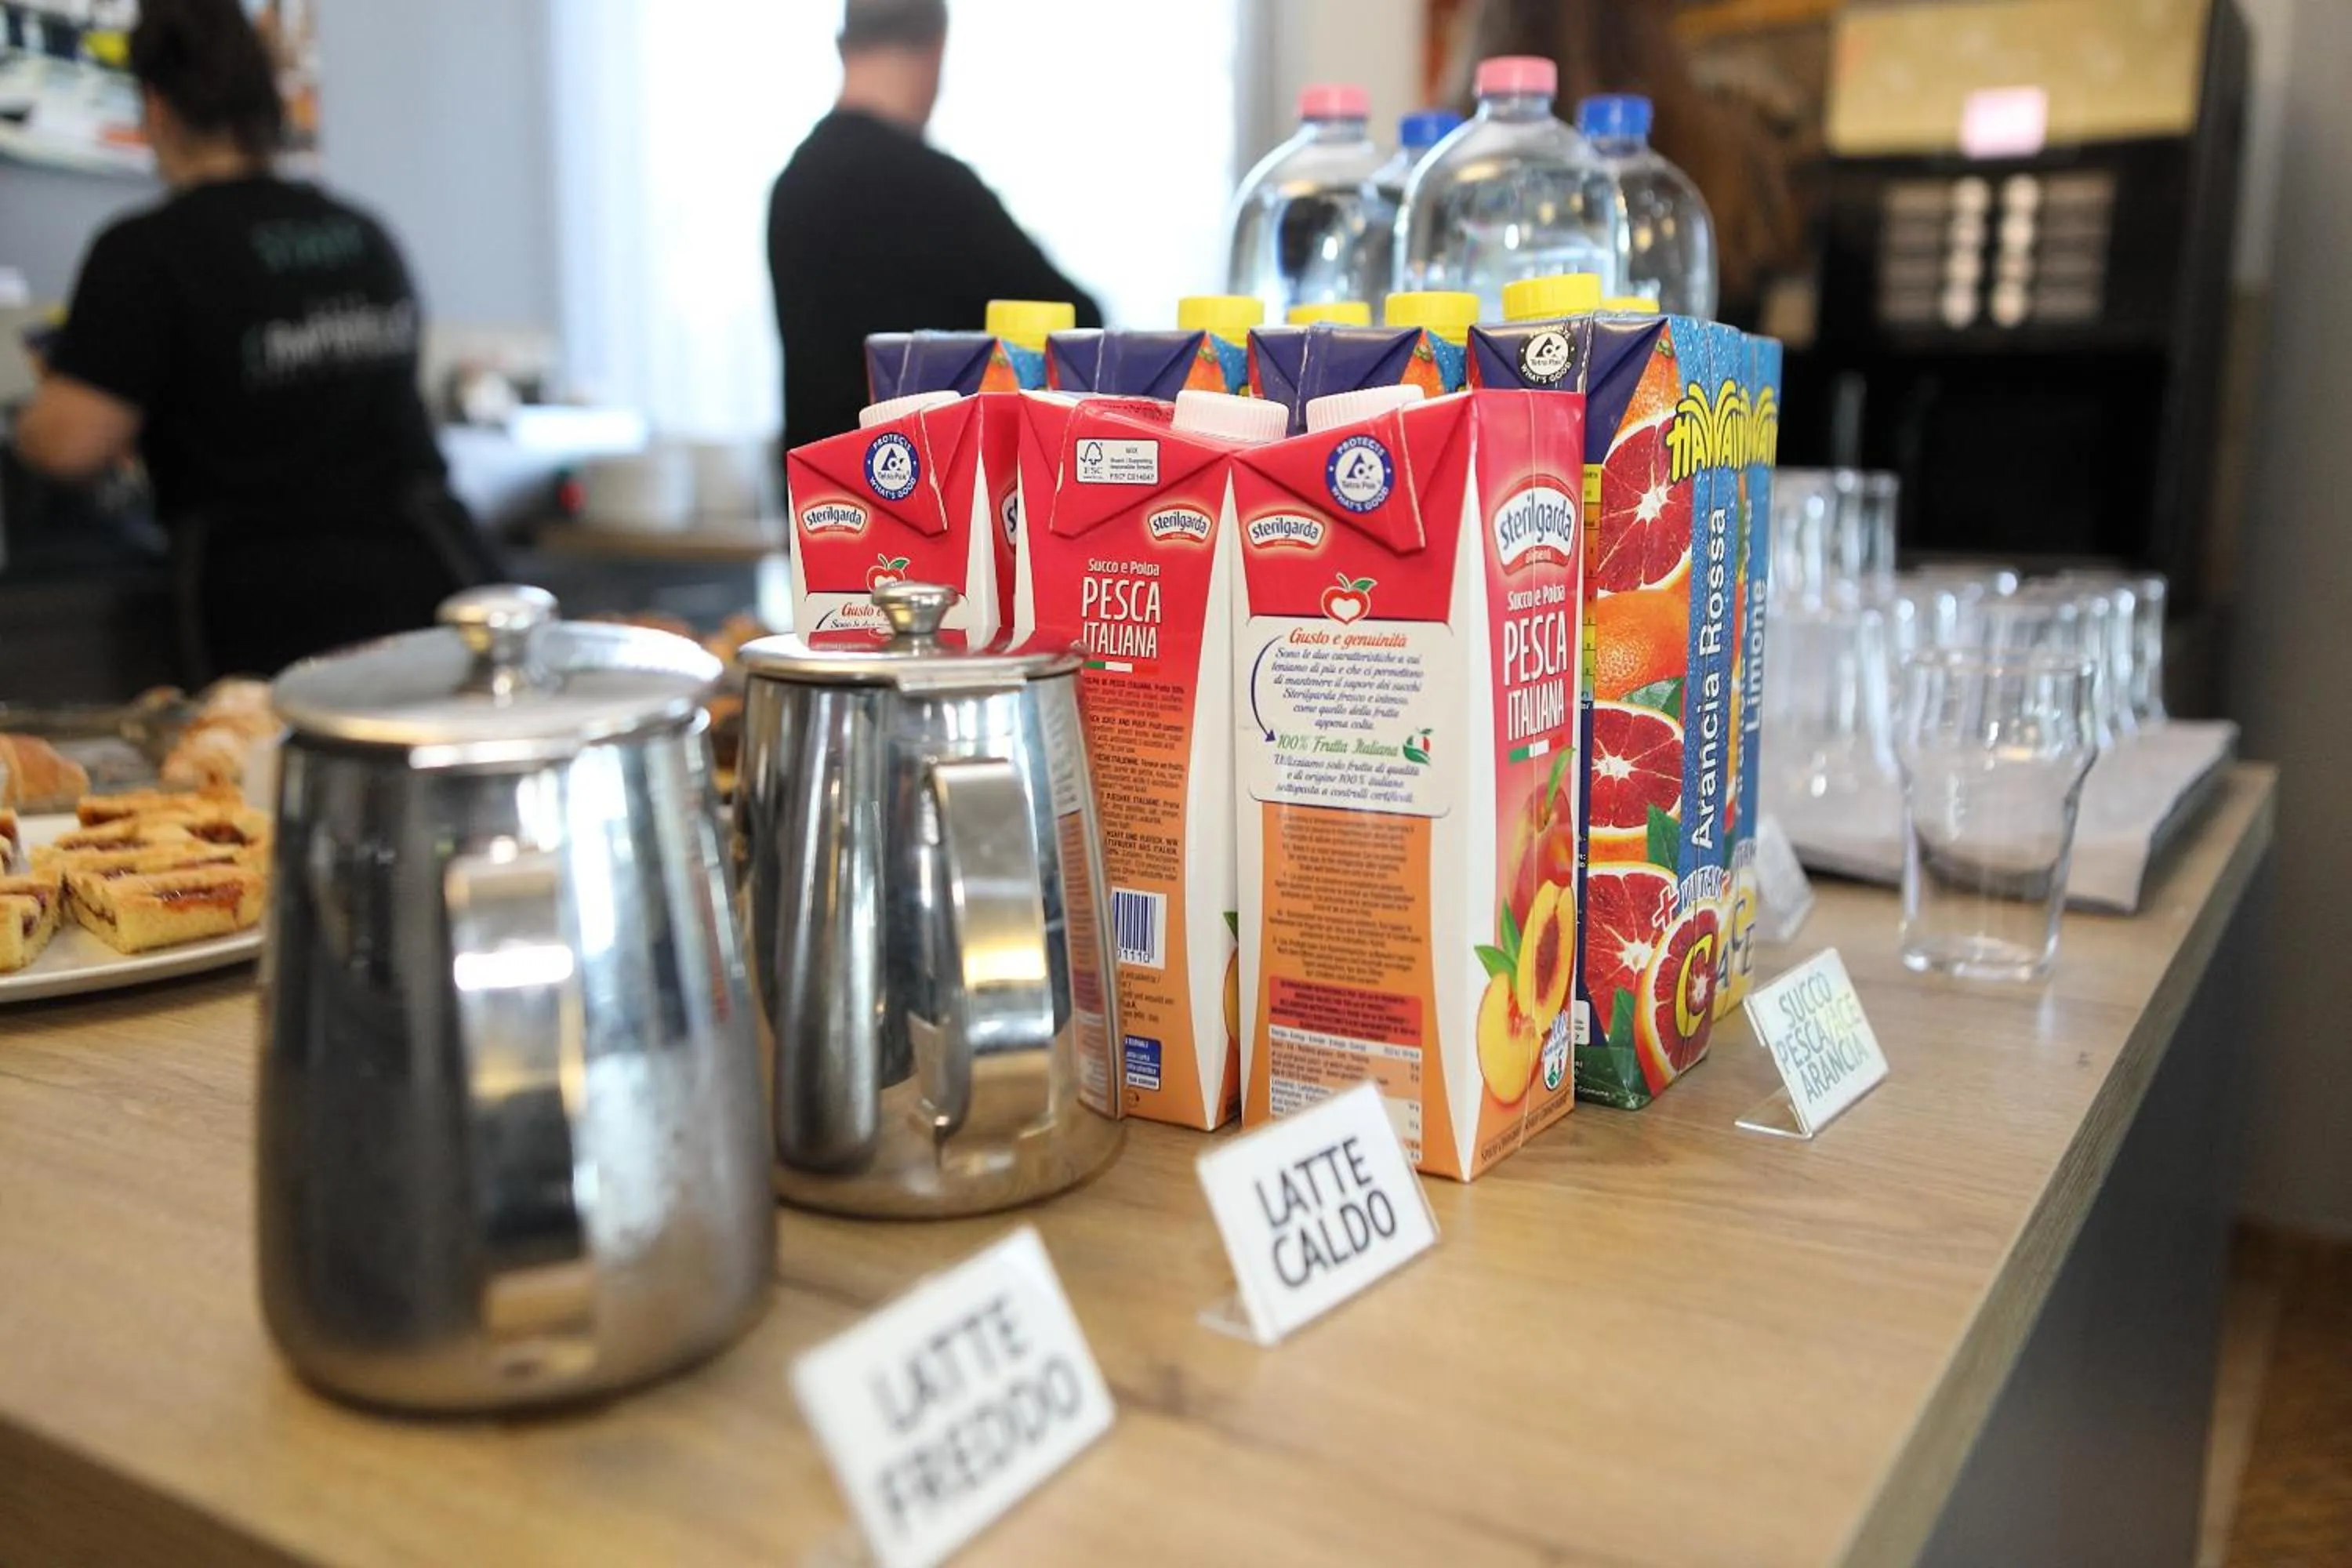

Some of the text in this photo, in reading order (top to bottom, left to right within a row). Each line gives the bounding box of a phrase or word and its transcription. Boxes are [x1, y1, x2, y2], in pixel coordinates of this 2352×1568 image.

[805, 506, 863, 527] sterilgarda
[1365, 486, 1389, 510] GOOD
[1152, 511, 1208, 535] sterilgarda
[1252, 517, 1319, 540] sterilgarda
[1499, 494, 1573, 550] sterilgarda
[1087, 557, 1119, 572] Succo
[1120, 562, 1128, 574] e
[841, 601, 874, 617] Gusto
[1081, 576, 1162, 624] PESCA
[1083, 621, 1157, 659] ITALIANA
[1275, 647, 1300, 659] Sono
[1289, 626, 1409, 650] Gusto e genuinità
[1503, 610, 1568, 687] PESCA
[1744, 577, 1767, 733] Limone
[1273, 673, 1283, 684] di
[1309, 662, 1319, 673] di
[1345, 666, 1362, 676] che
[1690, 506, 1726, 851] Arancia Rossa
[1283, 688, 1336, 702] Sterilgarda
[1508, 677, 1566, 742] ITALIANA
[1276, 733, 1399, 757] 100% Frutta Italiana
[1778, 971, 1833, 1029] SUCCO
[1799, 1032, 1870, 1104] ARANCIA
[1254, 1134, 1375, 1231] LATTE
[1270, 1187, 1398, 1290] CALDO
[873, 1294, 1030, 1432] LATTE
[876, 1361, 1083, 1534] FREDDO
